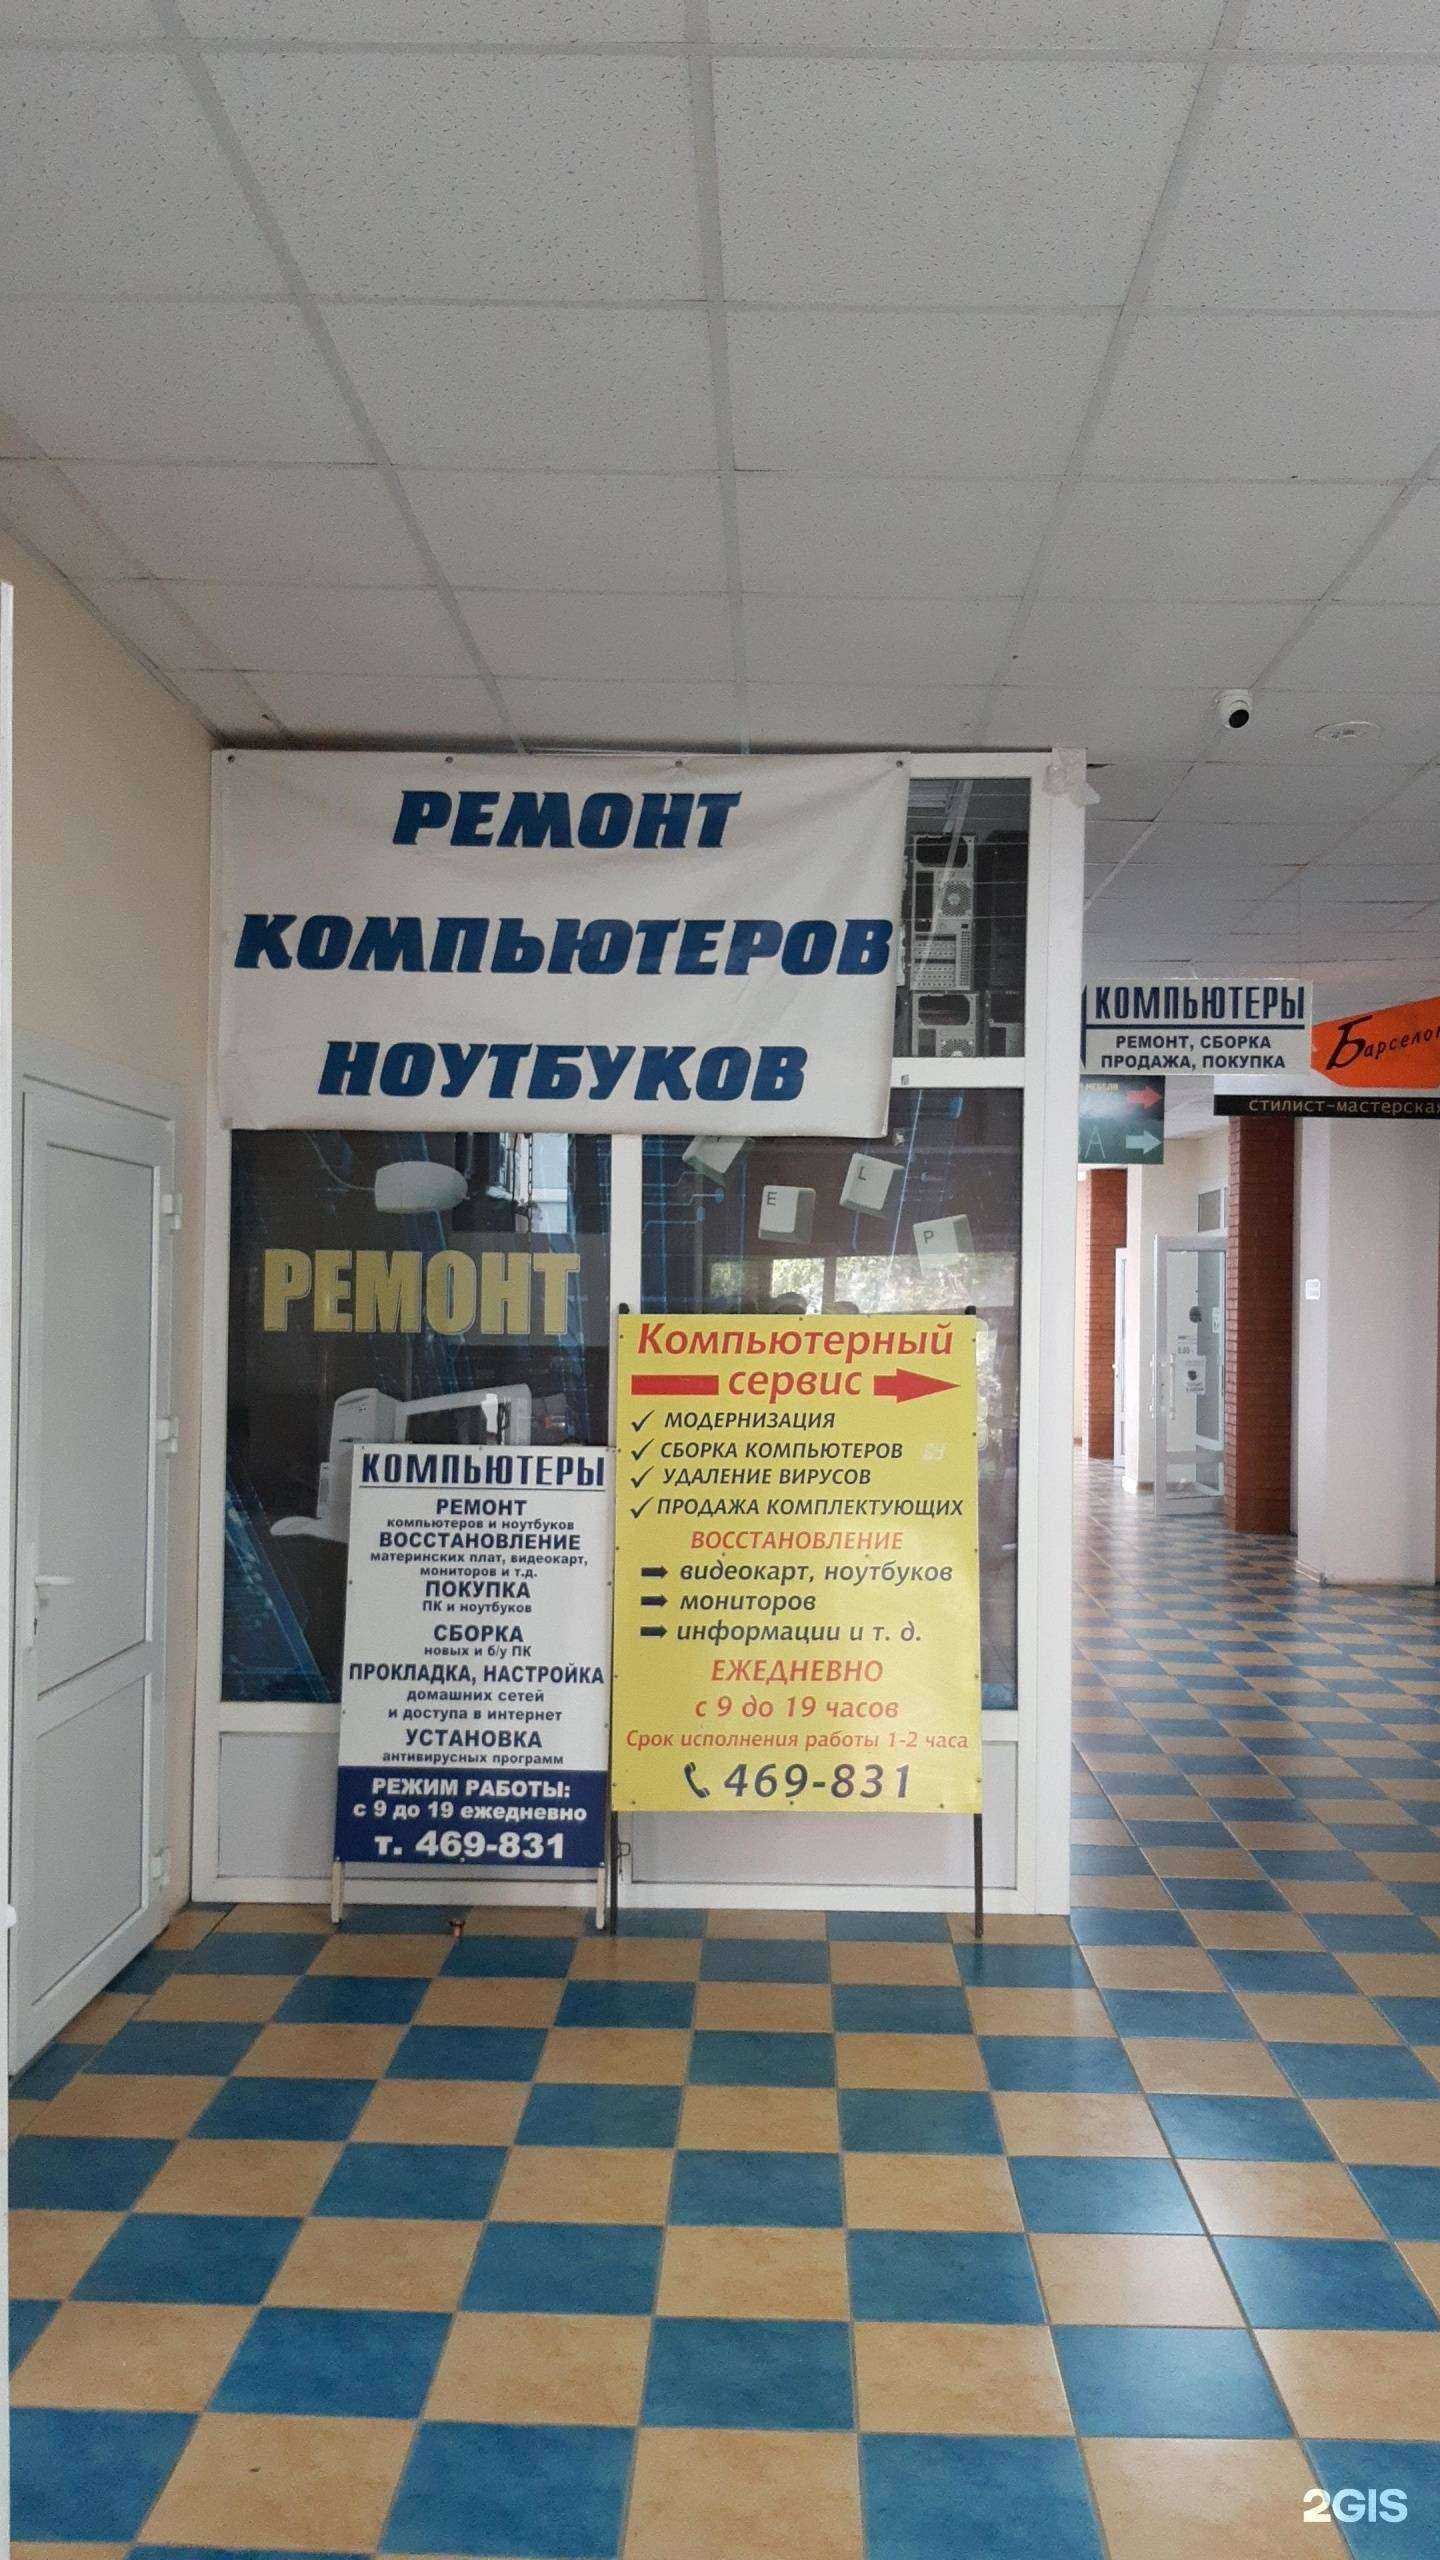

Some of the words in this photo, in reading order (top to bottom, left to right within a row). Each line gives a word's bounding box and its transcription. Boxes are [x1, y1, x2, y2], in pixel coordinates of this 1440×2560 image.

[392, 790, 743, 849] РЕМОНТ
[234, 913, 894, 976] КОМПЬЮТЕРОВ
[1095, 986, 1305, 1019] КОМПЬЮТЕРЫ
[1116, 1035, 1195, 1051] РЕМОНТ,
[1200, 1036, 1271, 1049] СБОРКА
[317, 1040, 808, 1102] НОУТБУКОВ
[1101, 1055, 1197, 1071] ПРОДАЖА,
[1202, 1056, 1286, 1069] ПОКУПКА
[263, 1248, 581, 1335] РЕМОНТ
[637, 1321, 955, 1364] Компьютерный
[728, 1370, 862, 1404] сервис
[664, 1412, 835, 1430] МОДЕРНИЗАЦИЯ
[661, 1442, 738, 1458] СБОРКА
[746, 1442, 903, 1459] КОМПЬЮТЕРОВ
[361, 1453, 605, 1487] КОМПЬЮТЕРЫ
[662, 1469, 771, 1486] УДАЛЕНИЕ
[779, 1469, 871, 1485] ВИРУСОВ
[436, 1499, 527, 1516] РЕМОНТ
[658, 1499, 759, 1517] ПРОДАЖА
[767, 1500, 963, 1517] КОМПЛЕКТУЮЩИХ
[387, 1519, 484, 1532] компьютеров
[488, 1521, 497, 1529] и
[502, 1518, 575, 1532] ноутбуков
[380, 1532, 581, 1550] ВОССТАНОВЛЕНИЕ
[690, 1531, 904, 1550] ВОССТАНОВЛЕНИЕ
[370, 1553, 465, 1564] материнских
[470, 1554, 506, 1564] плат,
[511, 1554, 588, 1567] видеокарт,
[420, 1567, 497, 1579] мониторов
[501, 1569, 510, 1577] и
[515, 1570, 538, 1581] т.д.
[680, 1561, 816, 1584] видеокарт,
[824, 1561, 953, 1585] ноутбуков
[425, 1581, 531, 1599] ПОКУПКА
[423, 1602, 442, 1612] ПК
[447, 1604, 455, 1612] и
[460, 1602, 532, 1615] ноутбуков
[680, 1595, 816, 1616] мониторов
[434, 1625, 524, 1642] СБОРКА
[677, 1621, 840, 1646] информации
[849, 1625, 864, 1641] и
[872, 1626, 891, 1641] т.
[900, 1622, 922, 1641] д.
[424, 1647, 469, 1656] новых
[474, 1648, 482, 1656] и
[487, 1645, 506, 1659] б/у
[511, 1646, 532, 1657] ПК
[349, 1663, 477, 1686] ПРОКЛАДКА,
[484, 1663, 605, 1684] НАСТРОЙКА
[711, 1659, 884, 1685] ЕЖЕДНЕВНО
[407, 1690, 492, 1703] домашних
[498, 1689, 545, 1702] сетей
[388, 1709, 397, 1718] и
[403, 1708, 467, 1721] доступа
[473, 1711, 481, 1719] в
[487, 1710, 562, 1723] интернет
[695, 1699, 707, 1718] с
[718, 1696, 732, 1718] 9
[742, 1695, 774, 1718] до
[786, 1696, 817, 1718] 19
[826, 1700, 900, 1718] часов
[405, 1729, 543, 1748] УСТАНОВКА
[626, 1730, 673, 1751] Срок
[681, 1731, 798, 1748] исполнения
[805, 1729, 879, 1751] работы
[886, 1732, 918, 1748] 1-2
[925, 1734, 969, 1749] часа
[382, 1752, 487, 1765] антивирусных
[492, 1754, 564, 1766] программ
[372, 1778, 458, 1796] РЕЖИМ
[465, 1779, 571, 1798] РАБОТЫ:
[724, 1762, 911, 1799] 469-831
[353, 1803, 367, 1817] с
[374, 1801, 387, 1817] 9
[393, 1803, 420, 1820] до
[428, 1801, 454, 1818] 19
[460, 1804, 587, 1822] ежедневно
[374, 1836, 403, 1855] т.
[415, 1830, 565, 1859] 469-831
